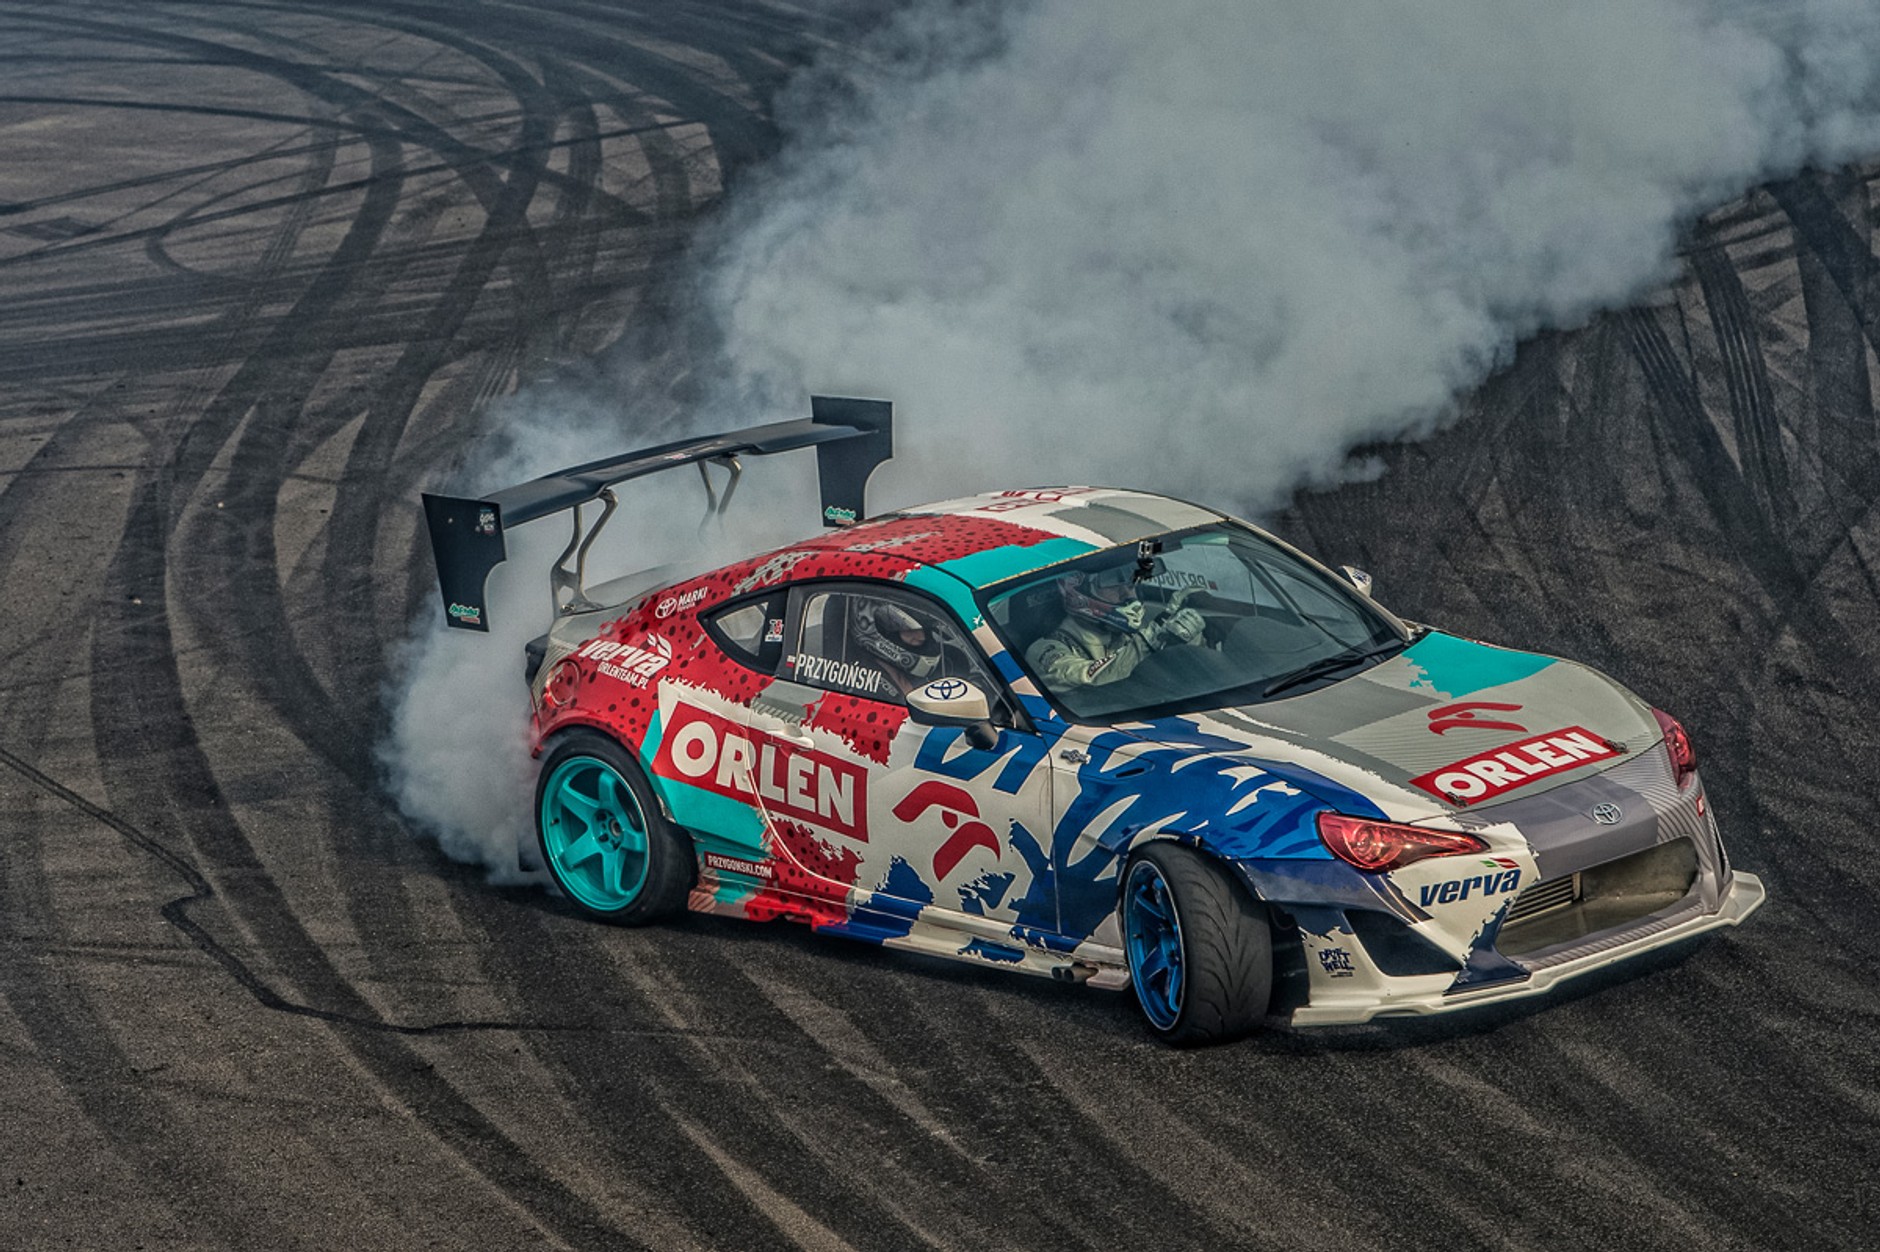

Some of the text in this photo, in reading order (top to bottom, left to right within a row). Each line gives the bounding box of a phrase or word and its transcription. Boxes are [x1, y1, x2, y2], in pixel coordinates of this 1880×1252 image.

[679, 587, 707, 605] MARKI
[578, 640, 669, 678] verva
[597, 661, 649, 690] ORLENTEAM.PL
[797, 654, 882, 693] PRZYGOŃSKI
[671, 720, 855, 827] ORLEN
[1434, 732, 1610, 798] ORLEN
[707, 854, 772, 878] PRZYGONSKI.COM
[1420, 869, 1521, 906] verva
